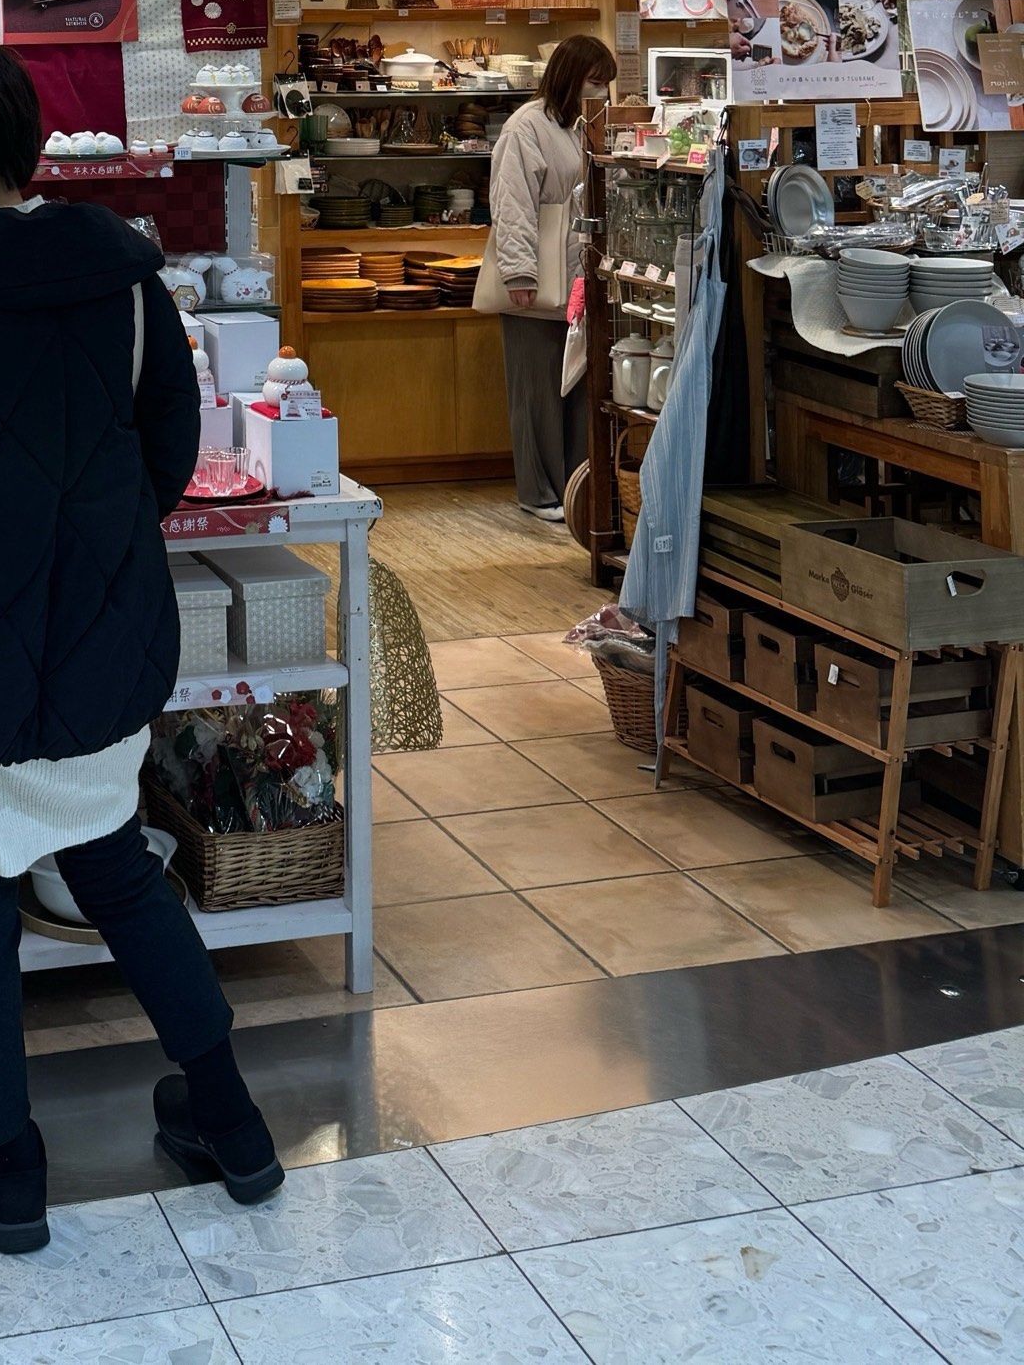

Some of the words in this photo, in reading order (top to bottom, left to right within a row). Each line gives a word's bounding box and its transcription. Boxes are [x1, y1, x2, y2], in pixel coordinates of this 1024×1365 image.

[72, 164, 124, 176] 年末大感謝祭
[807, 569, 831, 584] Marke
[850, 584, 874, 600] Gläser
